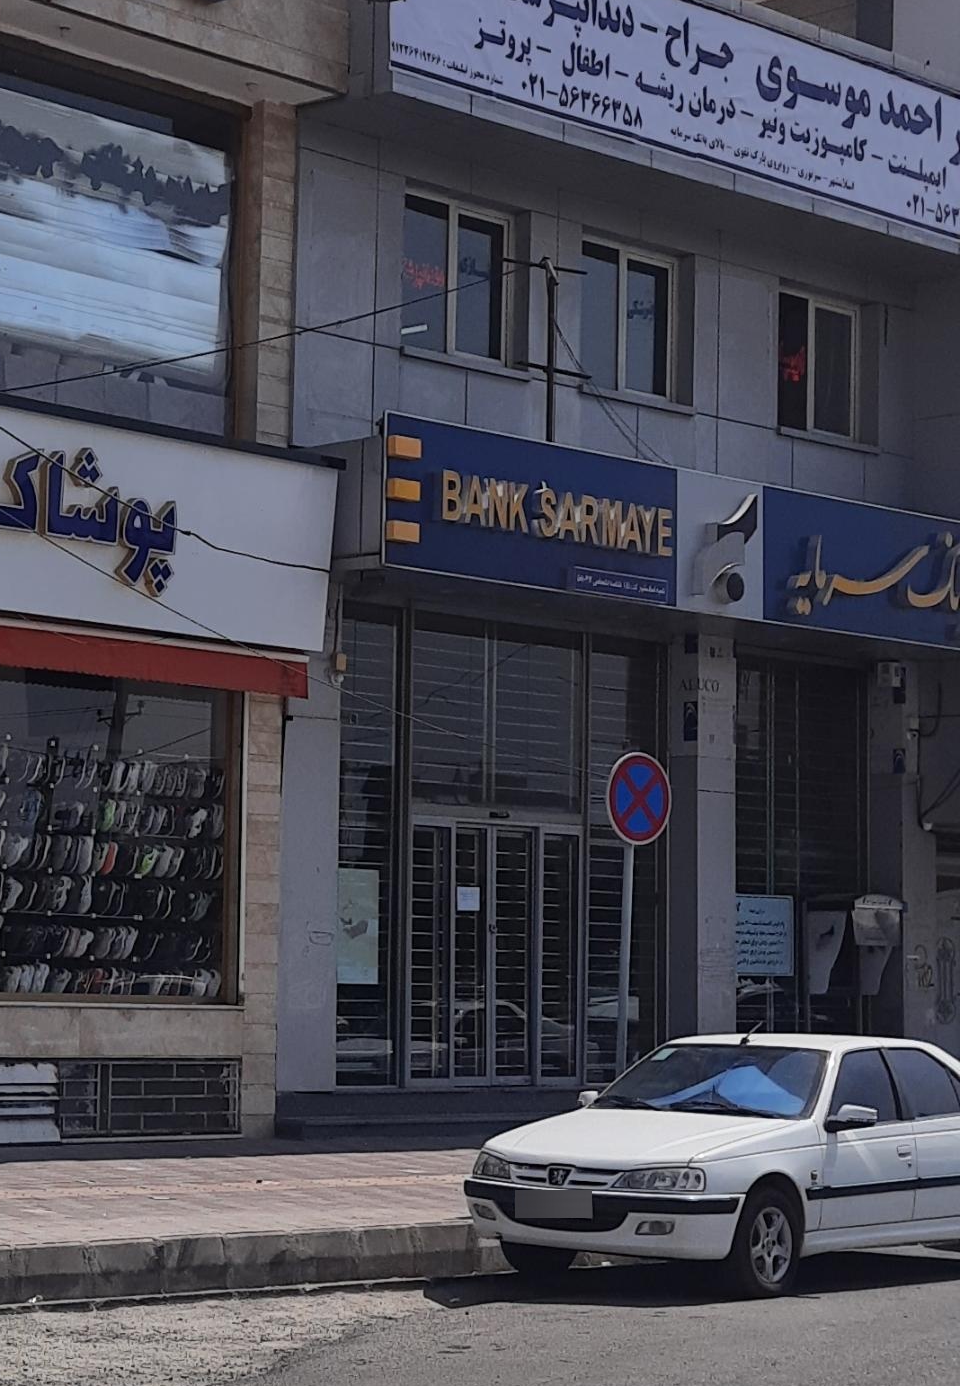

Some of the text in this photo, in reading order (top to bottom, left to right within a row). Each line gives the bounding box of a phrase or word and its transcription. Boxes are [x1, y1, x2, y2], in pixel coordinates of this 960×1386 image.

[474, 18, 532, 67] پروتز
[562, 40, 610, 81] اطفال
[664, 17, 735, 83] جراح
[635, 70, 685, 113] ریشه
[688, 86, 736, 125] درمان
[756, 55, 871, 129] موسوی
[880, 90, 942, 143] احمد
[440, 468, 674, 558] BANK SARMAYE
